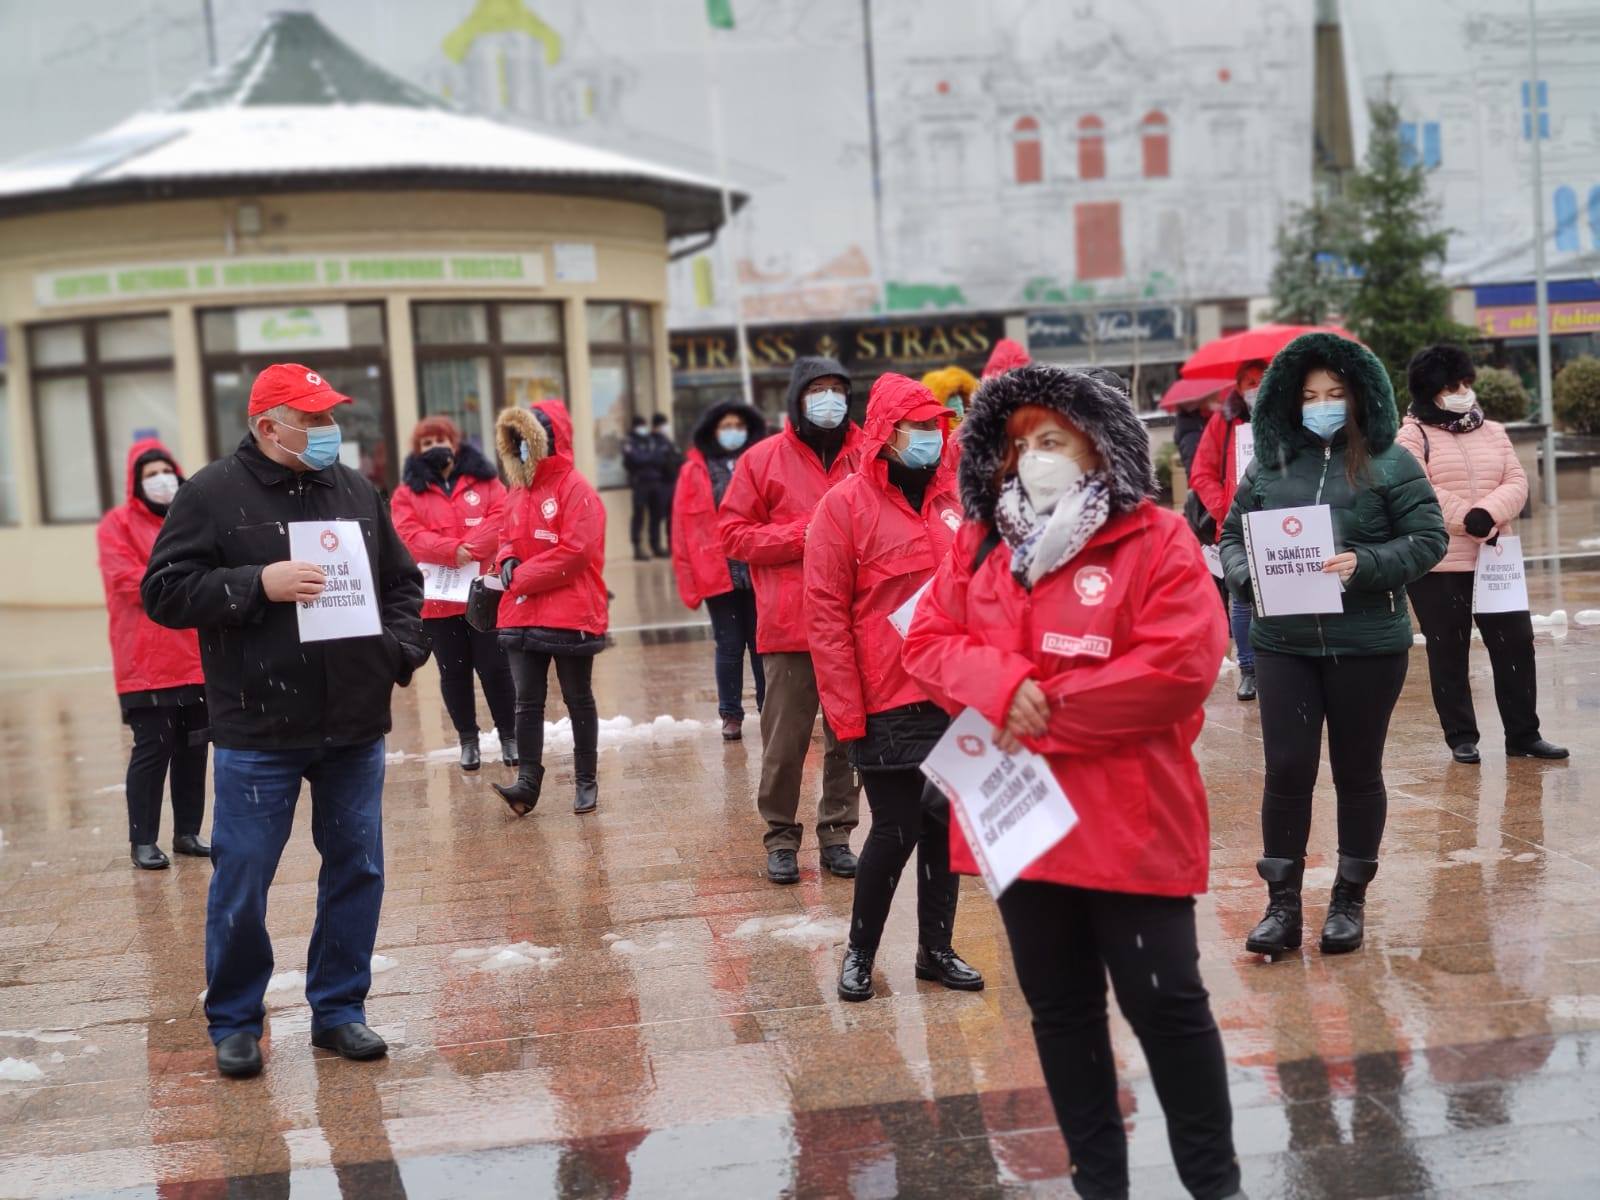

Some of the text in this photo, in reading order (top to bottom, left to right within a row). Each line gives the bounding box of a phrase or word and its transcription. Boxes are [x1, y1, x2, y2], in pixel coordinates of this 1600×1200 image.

[856, 321, 990, 360] STRASS
[1265, 546, 1321, 561] ÎN SĂNĂTATE
[337, 561, 350, 577] SĂ
[1265, 563, 1295, 576] EXISTĂ
[350, 579, 362, 591] NU
